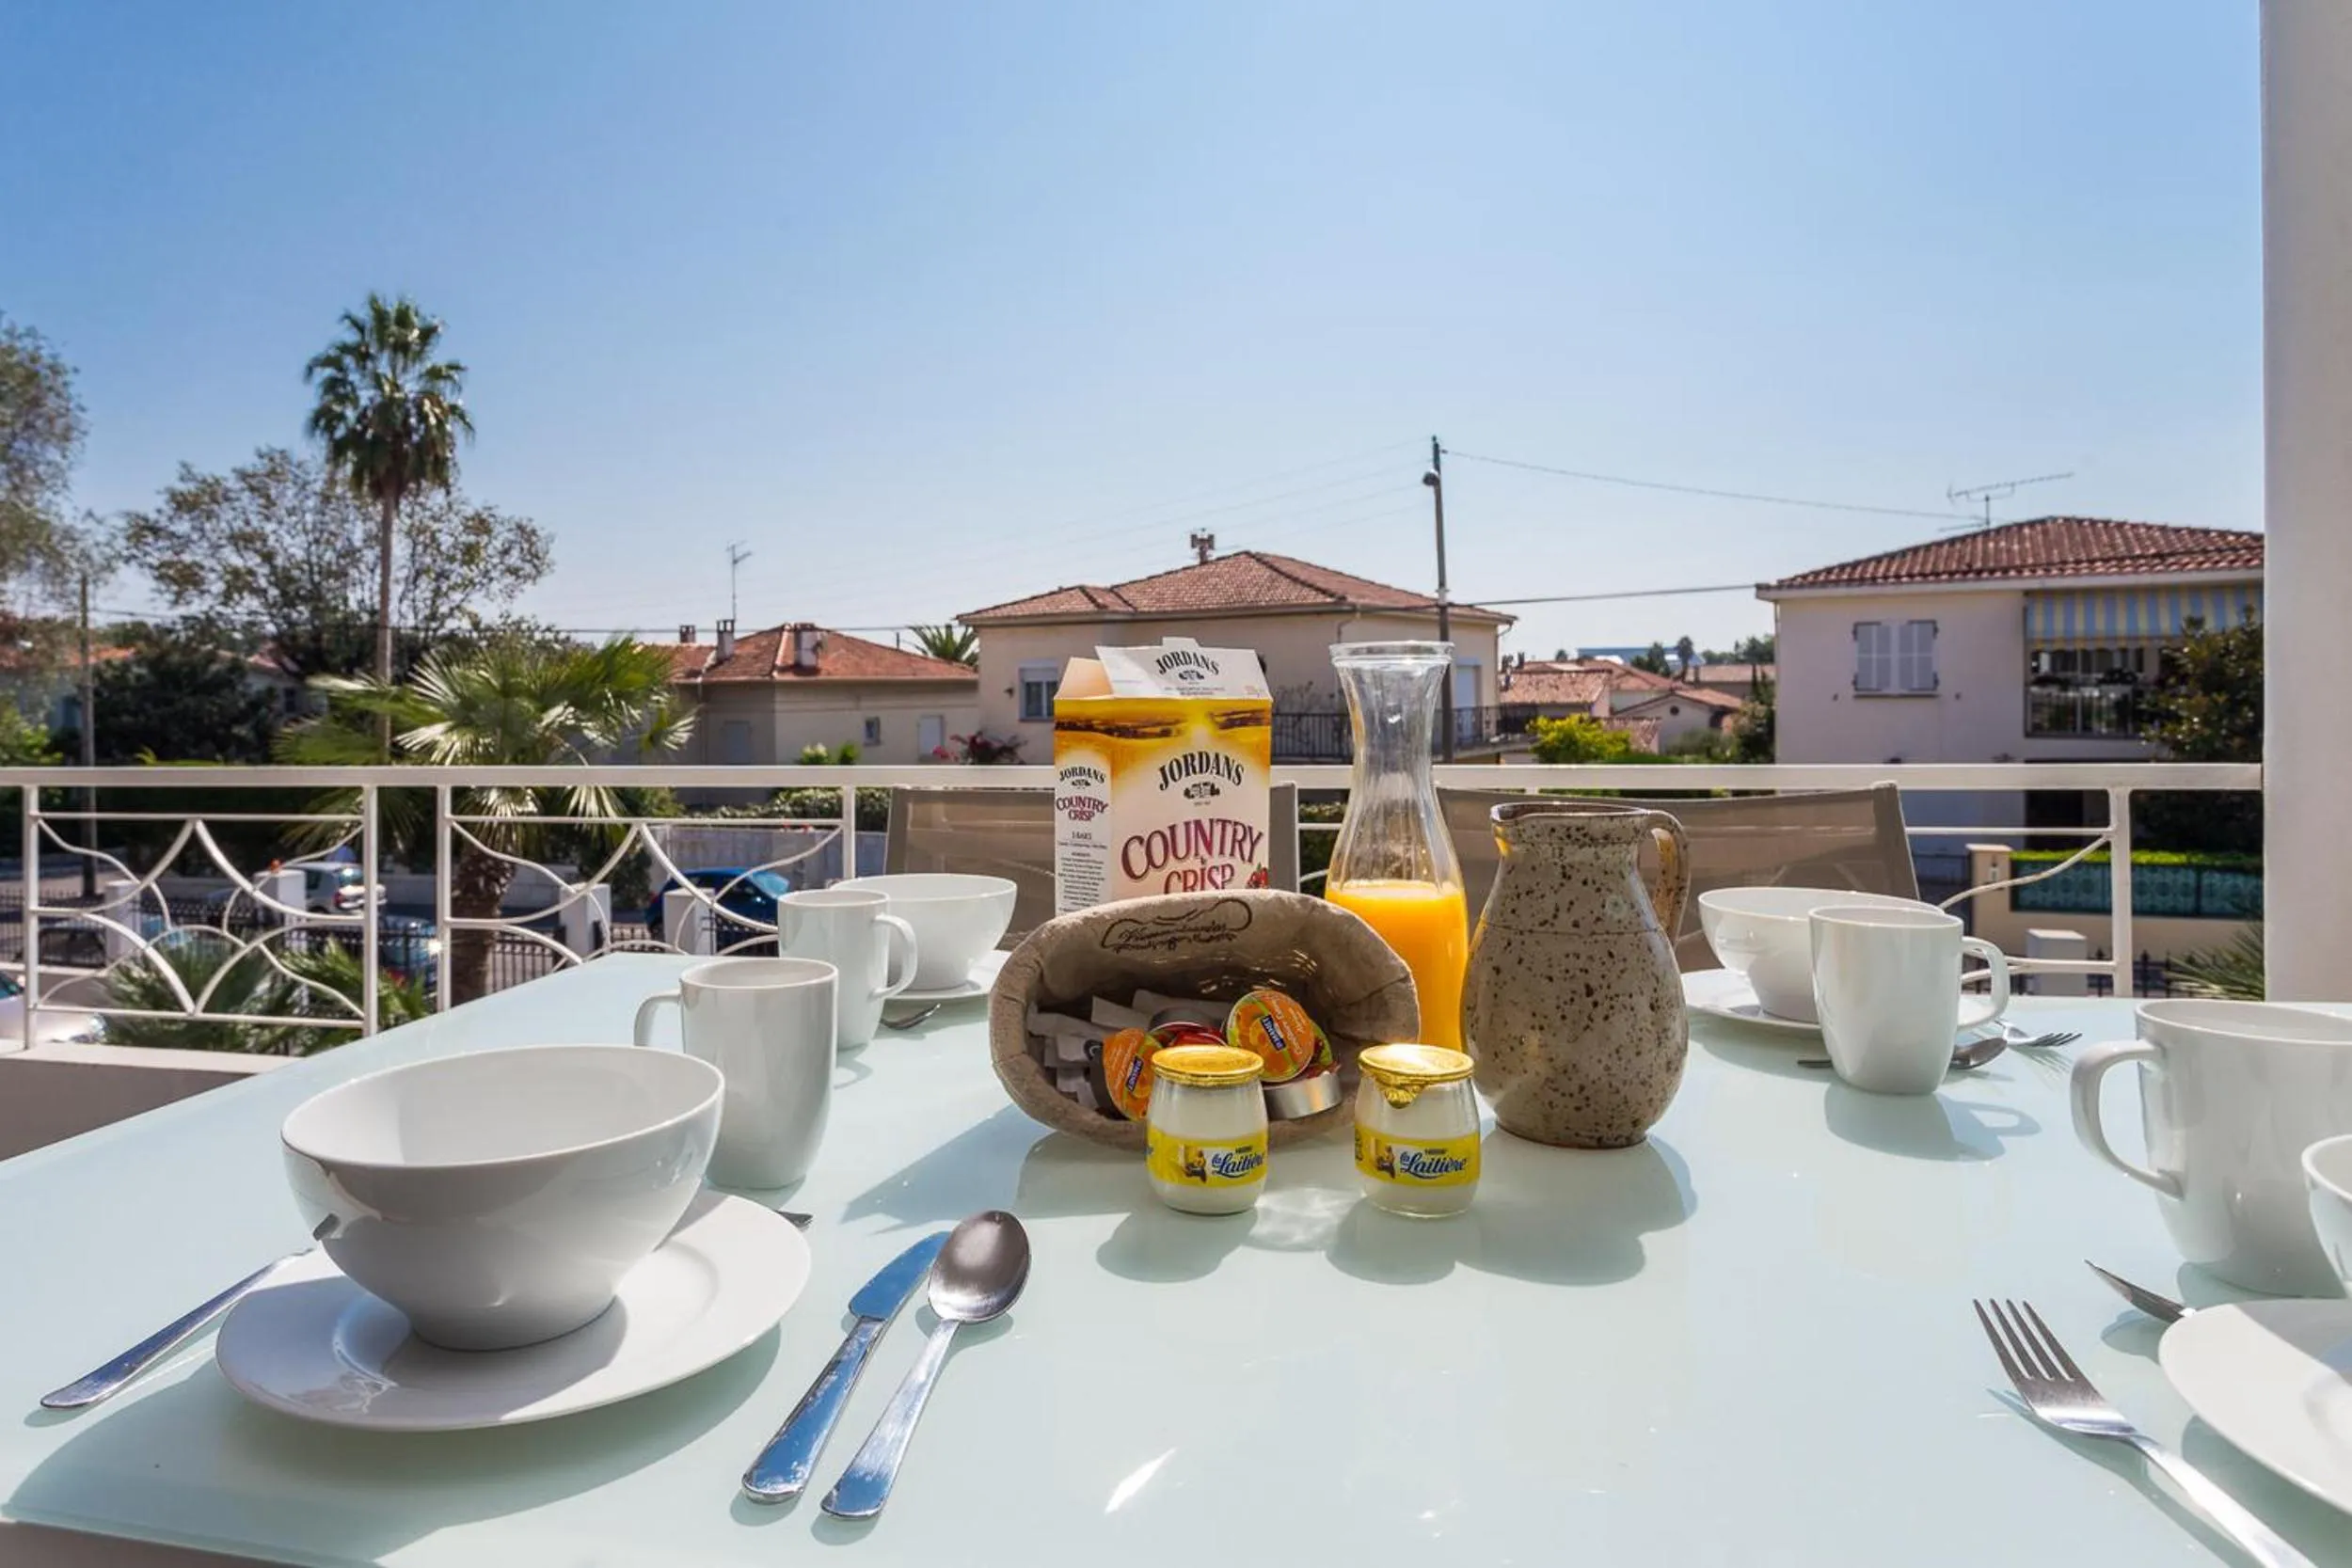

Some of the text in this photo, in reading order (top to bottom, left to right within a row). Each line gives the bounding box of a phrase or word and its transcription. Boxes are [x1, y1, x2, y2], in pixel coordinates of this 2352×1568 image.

[1155, 650, 1219, 675] JORDANS
[1059, 766, 1106, 784] JORDANS
[1158, 751, 1245, 791] JORDANS
[1056, 796, 1109, 815] COUNTRY
[1068, 810, 1096, 822] CRISP
[1120, 817, 1264, 881] COUNTRY
